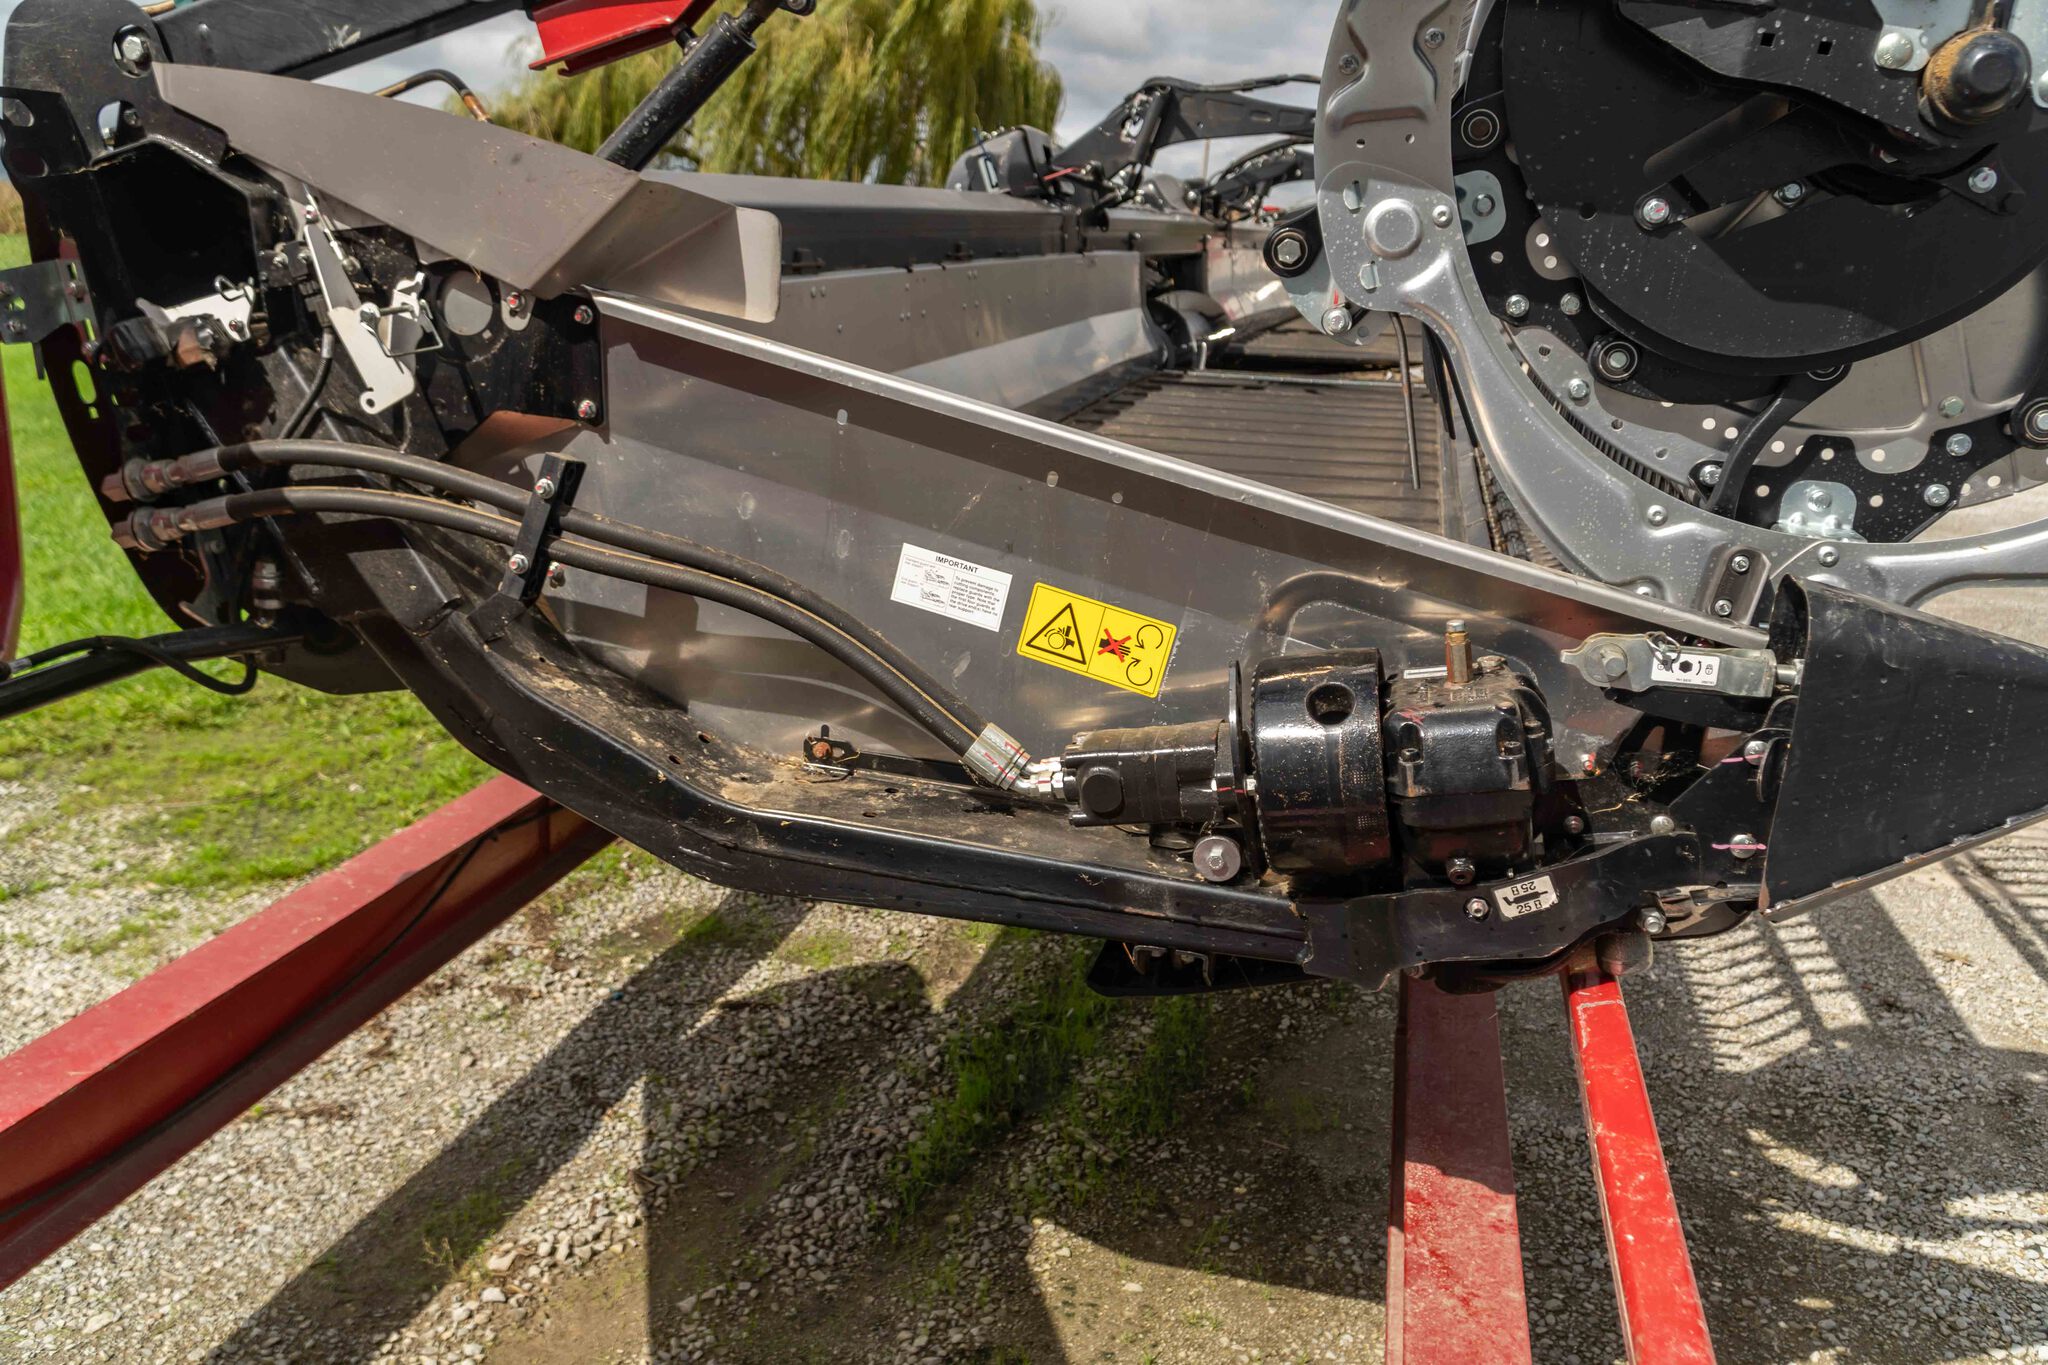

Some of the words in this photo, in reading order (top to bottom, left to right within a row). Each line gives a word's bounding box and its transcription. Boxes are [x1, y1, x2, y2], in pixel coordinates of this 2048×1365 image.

[935, 556, 978, 574] IMPORTANT
[1520, 881, 1537, 893] 25
[1516, 902, 1532, 914] 25
